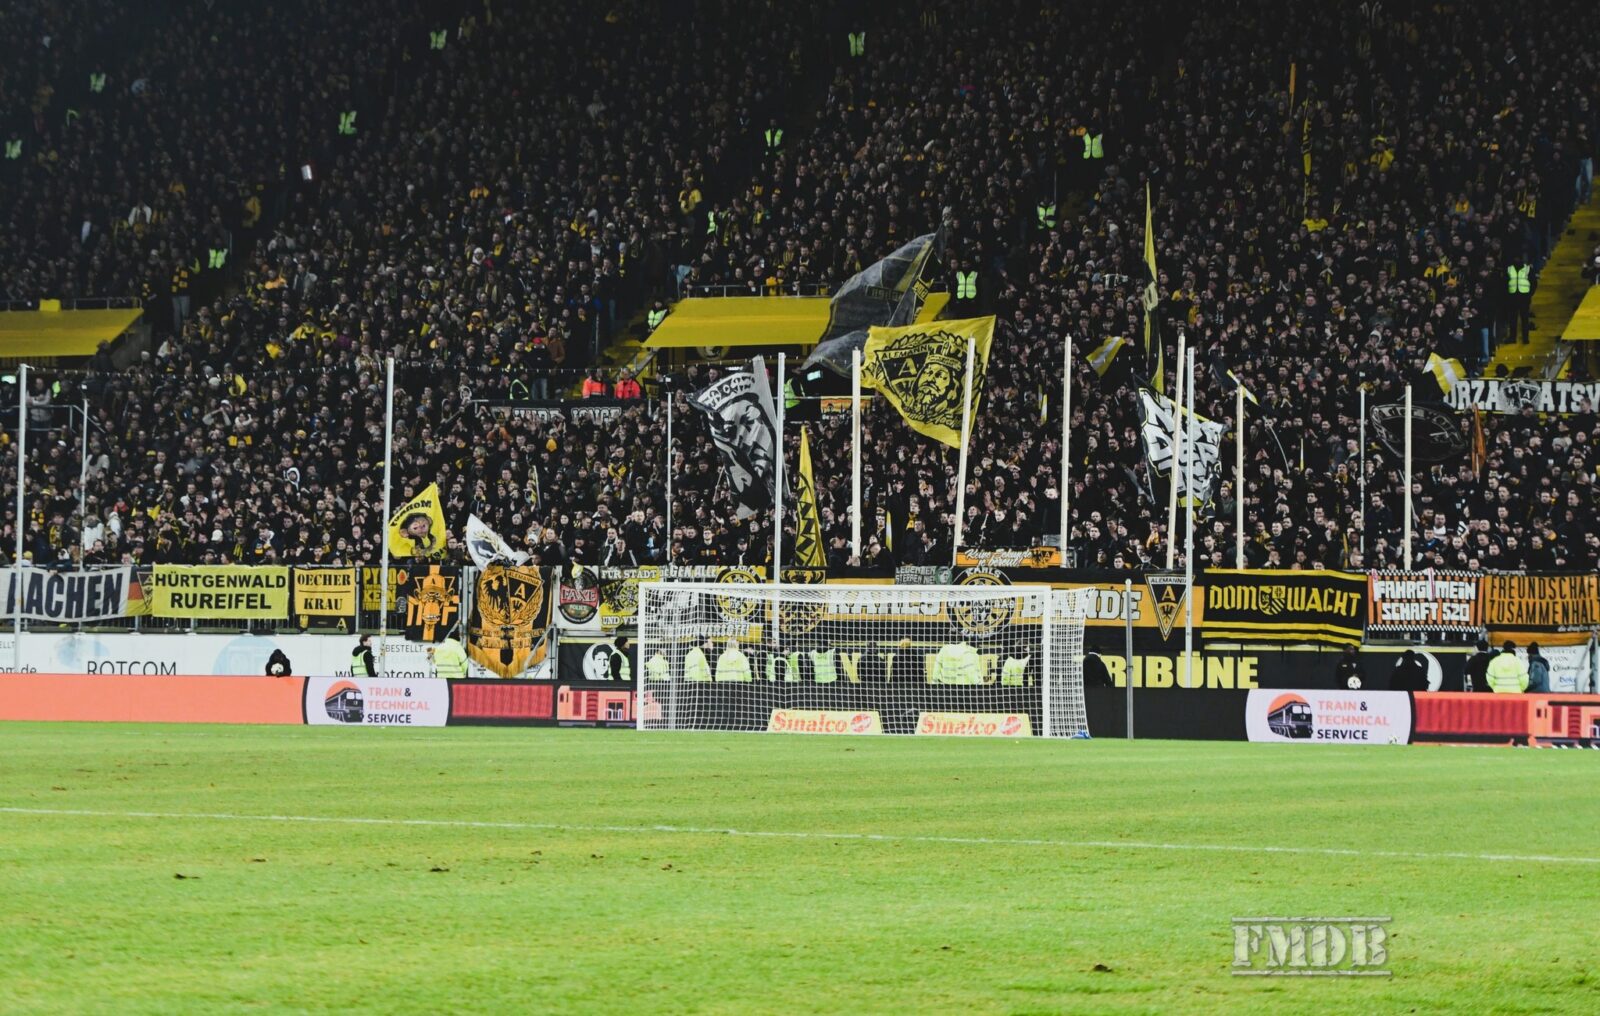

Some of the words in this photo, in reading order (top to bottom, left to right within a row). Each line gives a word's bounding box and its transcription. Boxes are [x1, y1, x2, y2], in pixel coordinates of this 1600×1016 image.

[155, 571, 286, 588] HÜRTGENWALD
[297, 574, 351, 586] OECHER
[363, 567, 397, 585] PYO
[623, 569, 657, 579] STADT
[170, 593, 272, 609] RUREIFEL
[363, 590, 397, 603] KEN
[1286, 586, 1361, 617] WACHT
[303, 598, 343, 610] KRAU
[1382, 602, 1438, 621] SCHAFT
[1442, 603, 1470, 621] 520
[603, 616, 620, 625] UND
[368, 687, 402, 697] TRAIN
[404, 688, 412, 697] &
[367, 701, 430, 711] TECHNICAL
[1317, 700, 1357, 711] TRAIN
[1360, 702, 1368, 711] &
[367, 714, 411, 723] SERVICE
[772, 711, 848, 733] Sinalco
[920, 713, 998, 736] Sinalco
[1317, 715, 1390, 726] TECHNICAL
[1317, 729, 1369, 740] SERVICE
